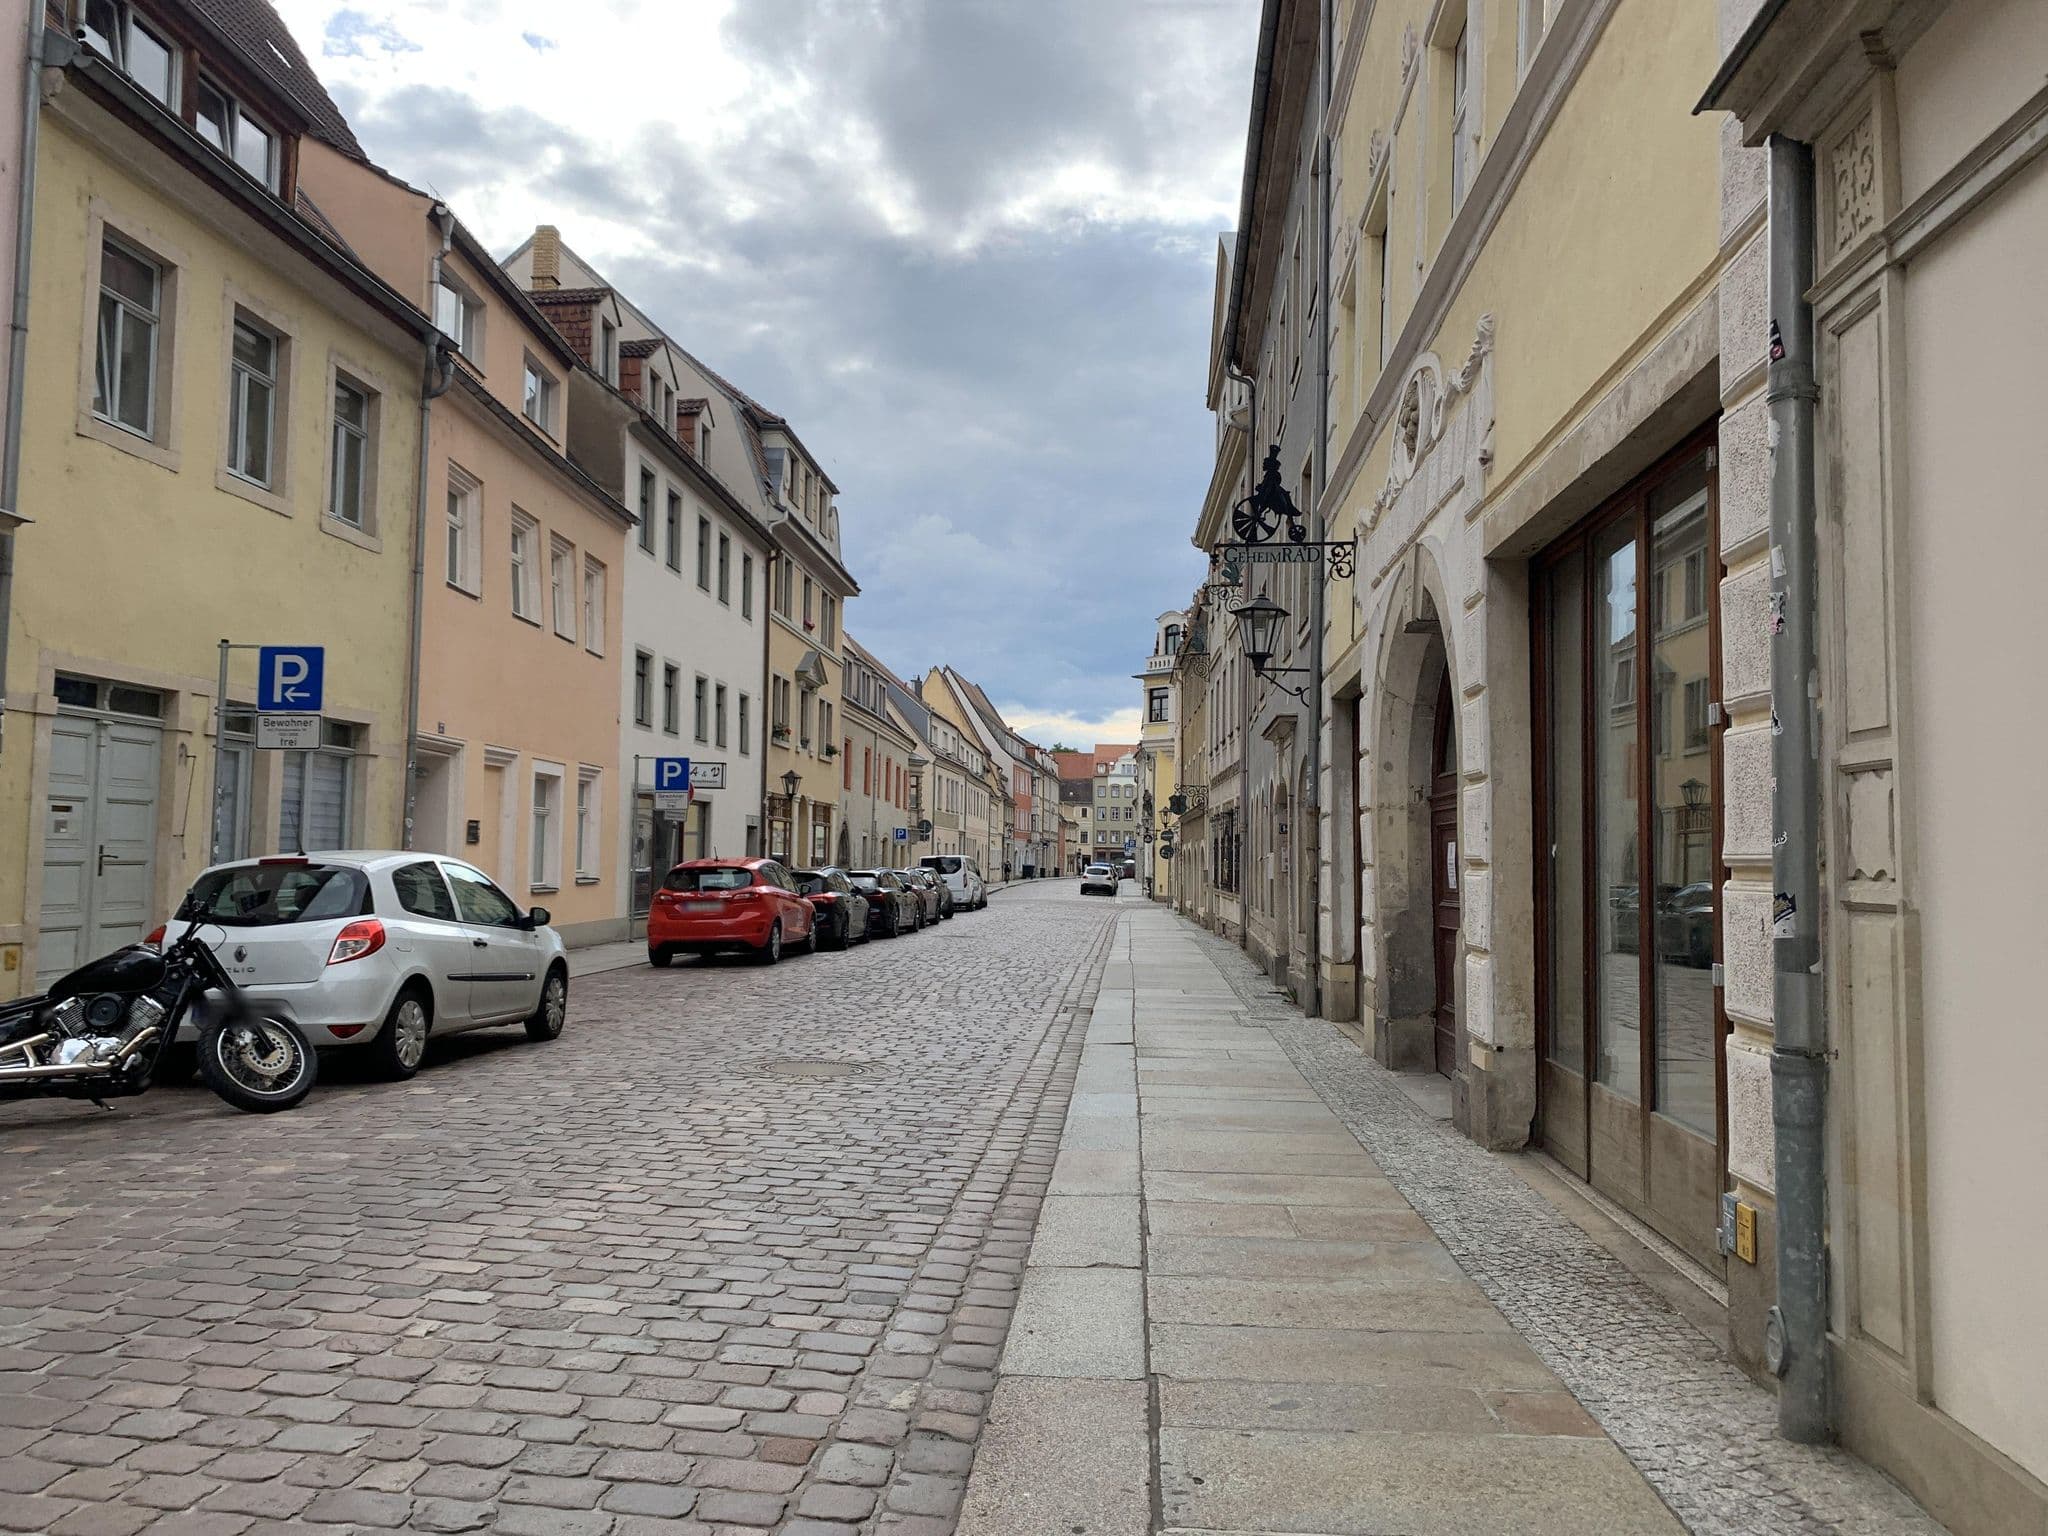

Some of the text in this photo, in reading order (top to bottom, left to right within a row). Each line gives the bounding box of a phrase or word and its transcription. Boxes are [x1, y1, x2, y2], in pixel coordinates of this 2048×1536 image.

[273, 654, 309, 703] P
[263, 718, 313, 727] Bewohner
[280, 738, 297, 747] frei
[663, 761, 682, 787] P
[690, 766, 698, 776] A
[897, 829, 905, 839] P
